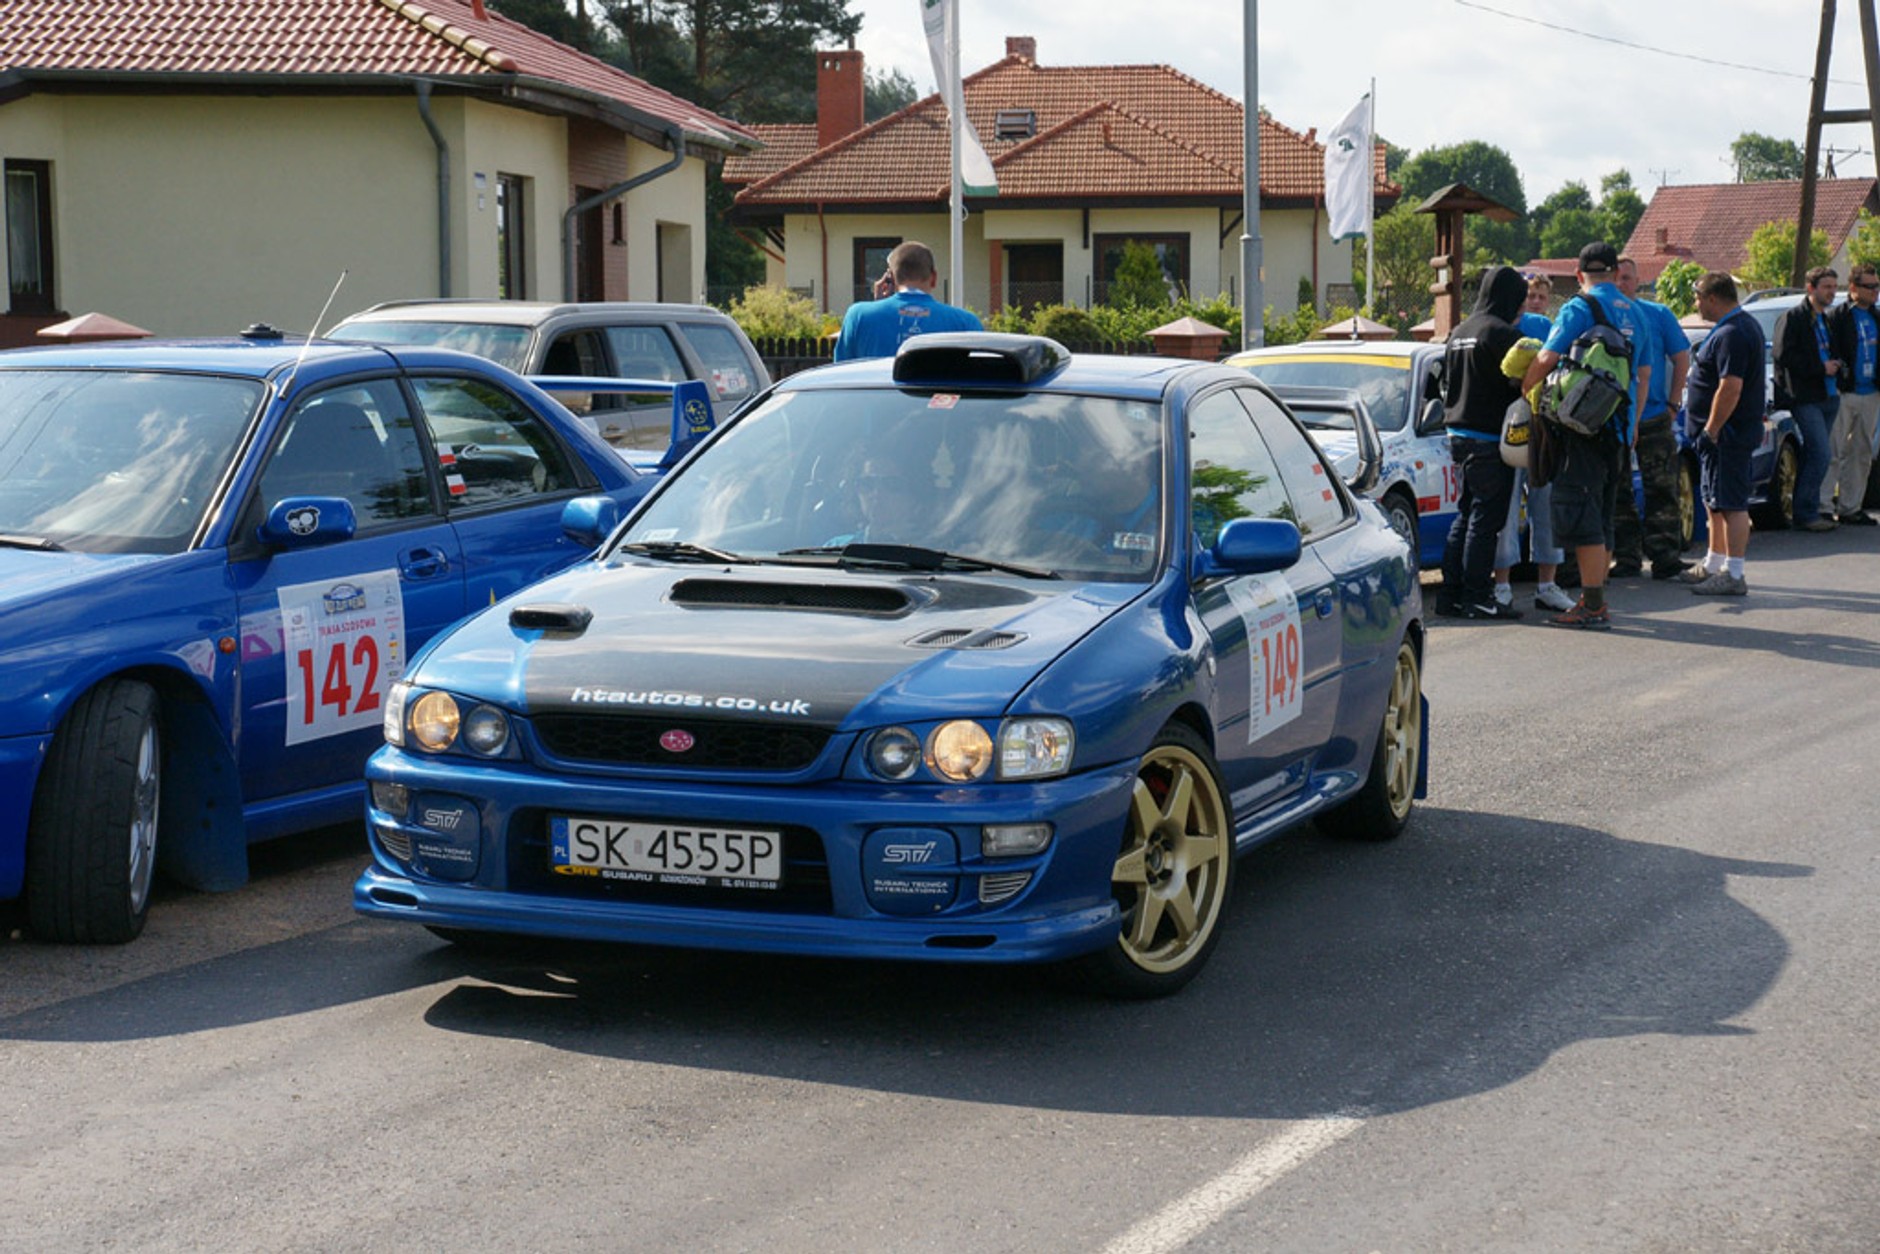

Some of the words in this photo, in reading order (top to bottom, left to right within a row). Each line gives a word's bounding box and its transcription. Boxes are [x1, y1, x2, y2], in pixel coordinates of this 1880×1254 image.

[1261, 623, 1299, 716] 149
[298, 635, 380, 725] 142
[571, 687, 811, 715] htautos.co.uk
[554, 846, 567, 857] PL
[576, 824, 629, 866] SK
[647, 830, 773, 875] 4555P
[602, 870, 653, 881] SUBARU
[874, 879, 910, 888] SUBARU
[874, 886, 948, 894] INTERNATIONAL
